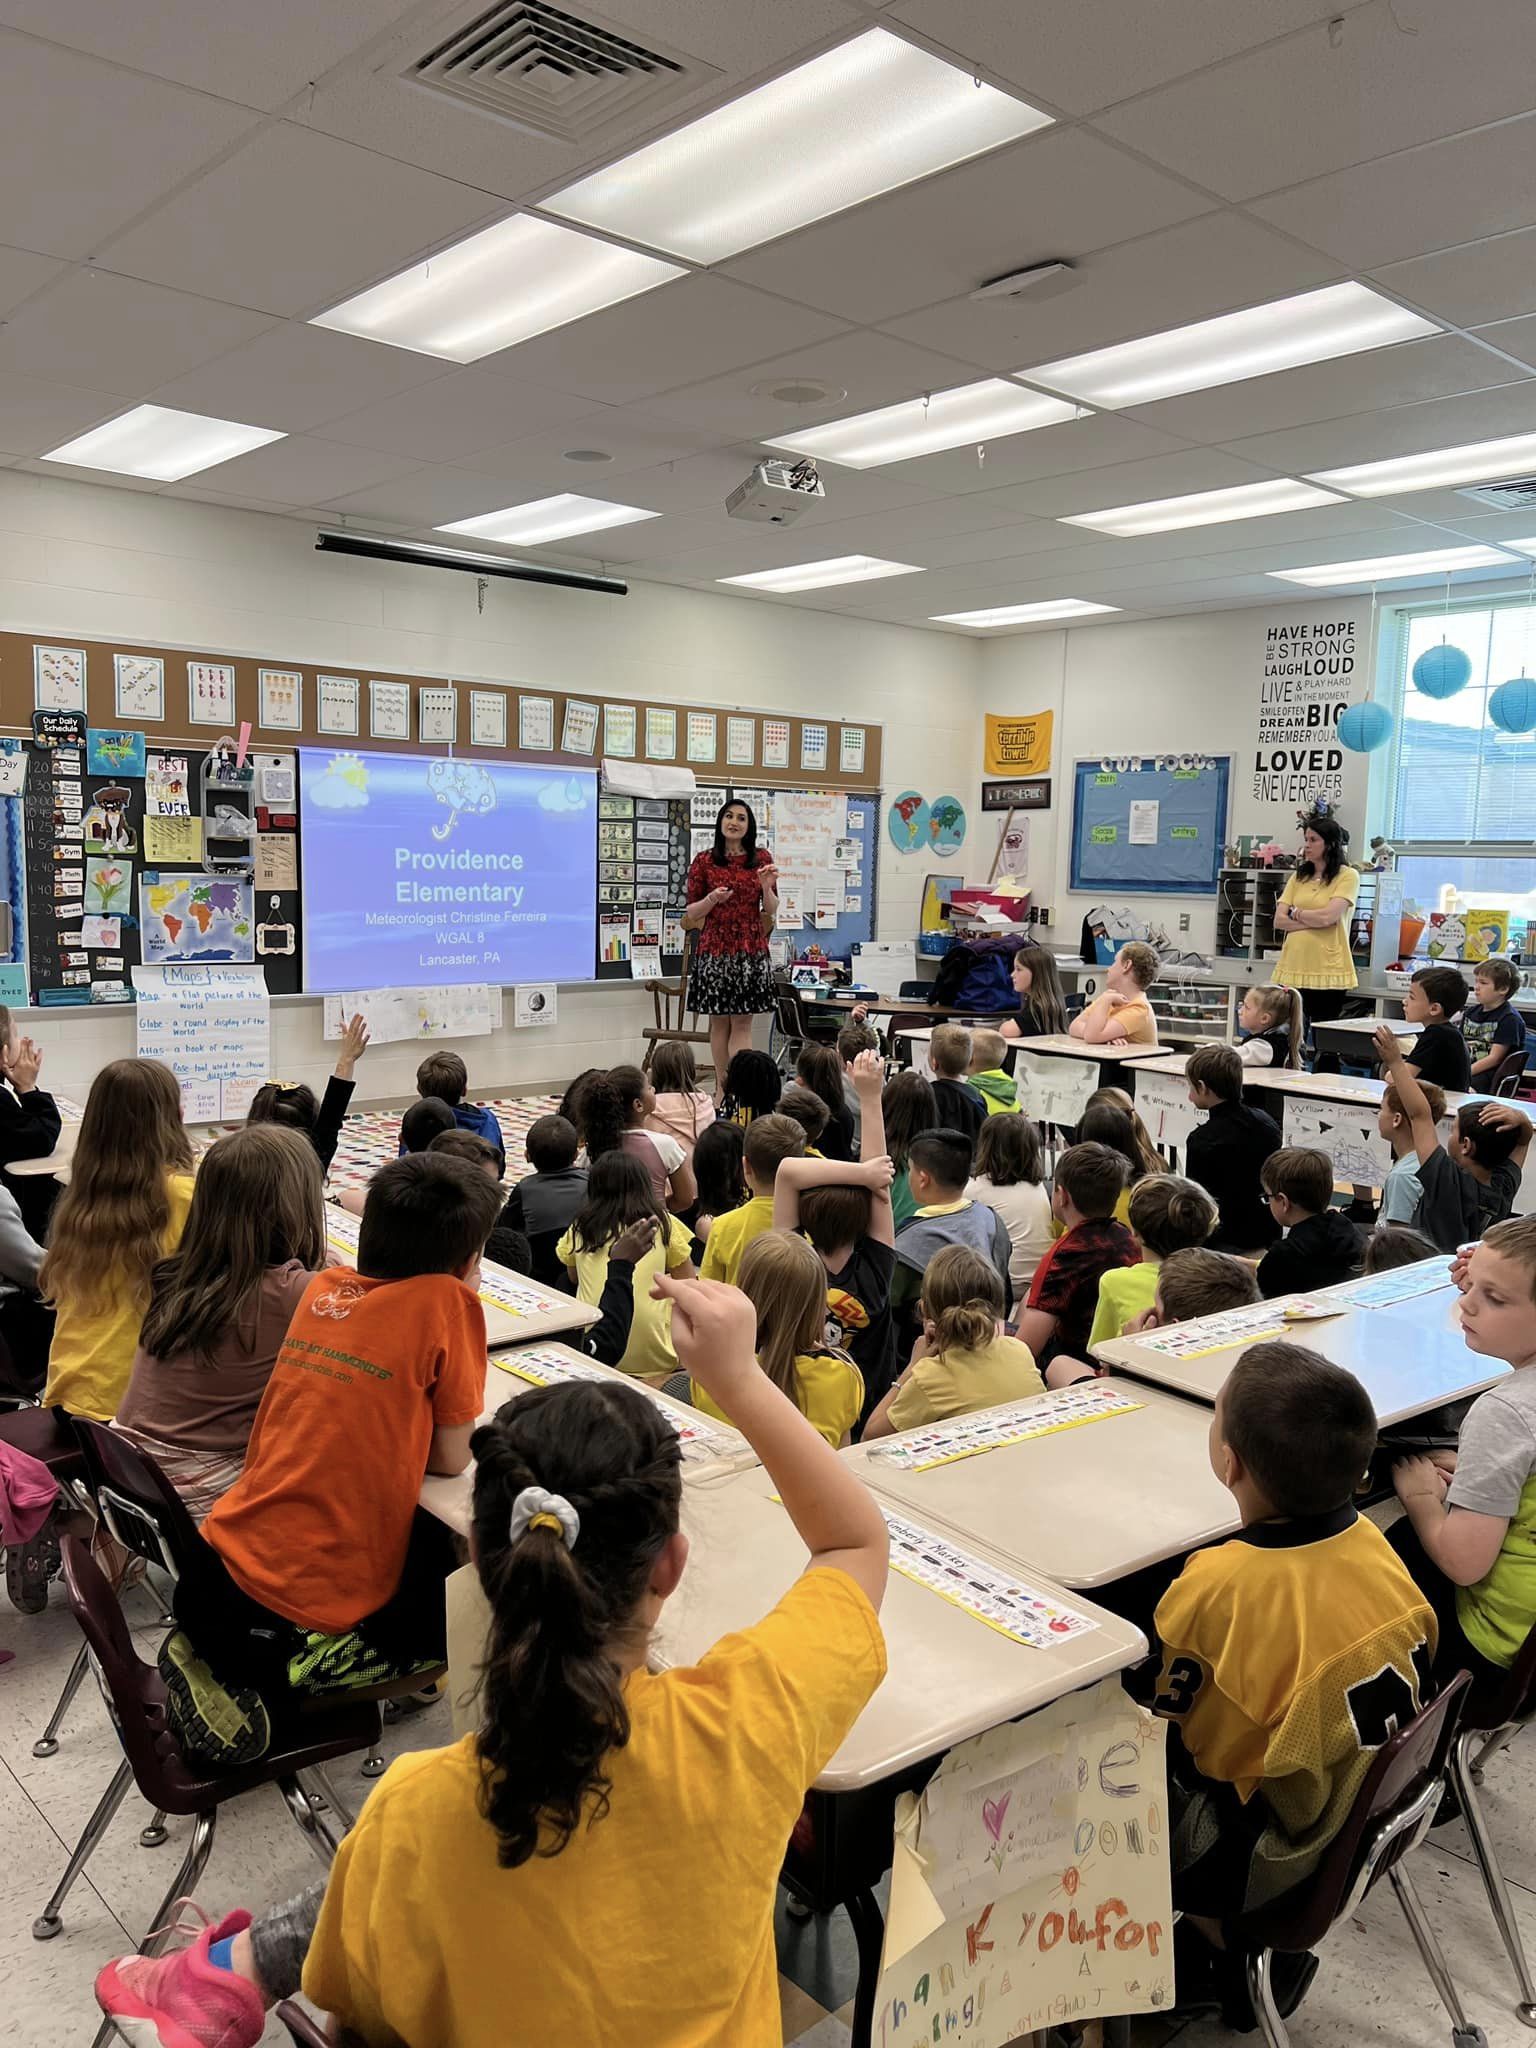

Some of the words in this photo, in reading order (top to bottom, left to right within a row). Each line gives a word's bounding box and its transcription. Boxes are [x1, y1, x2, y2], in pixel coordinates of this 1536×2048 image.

[1267, 625, 1308, 641] HAVE
[1313, 622, 1355, 638] HOPE
[1266, 644, 1275, 660] BE
[1279, 638, 1355, 659] STRONG
[1265, 663, 1303, 676] LAUGH
[1304, 657, 1354, 676] LOUD
[1261, 681, 1293, 703] LIVE
[1296, 681, 1302, 691] &
[1304, 680, 1326, 689] PLAY
[1327, 677, 1351, 687] HARD
[1303, 692, 1317, 701] THE
[1318, 690, 1350, 701] MOMENT
[1260, 707, 1281, 716] SMILE
[1282, 706, 1305, 716] OFTEN
[42, 717, 56, 725] Our
[59, 717, 78, 727] Daily
[44, 724, 79, 732] Schedule
[1260, 718, 1304, 728] DREAM
[999, 728, 1035, 745] terrible
[1258, 730, 1312, 743] REMEMBER
[1312, 730, 1330, 742] YOU
[158, 759, 187, 772] BEST
[1100, 756, 1143, 773] OUR
[1255, 749, 1343, 772] LOVED
[2, 772, 9, 780] 2
[1253, 773, 1261, 800] AND
[1261, 775, 1308, 802] NEVER
[1309, 774, 1342, 788] EVER
[159, 801, 188, 816] EVER
[64, 848, 80, 856] Gym
[395, 848, 524, 870] Providence
[396, 881, 524, 907] Elementary
[365, 912, 447, 926] Meteorologist
[451, 911, 500, 923] Christine
[503, 910, 547, 922] Ferreira
[435, 932, 473, 944] WGAL
[477, 932, 485, 943] 8
[483, 952, 500, 963] PA
[171, 967, 203, 984] Maps
[139, 991, 160, 1001] Map
[205, 991, 233, 1002] picture
[249, 991, 262, 999] the
[139, 1018, 162, 1028] Globe
[184, 1018, 207, 1027] round
[139, 1046, 164, 1055] Atlas
[185, 1044, 204, 1052] book
[223, 1044, 244, 1052] maps
[887, 1519, 927, 1545] imberly
[928, 1544, 969, 1568] Markey
